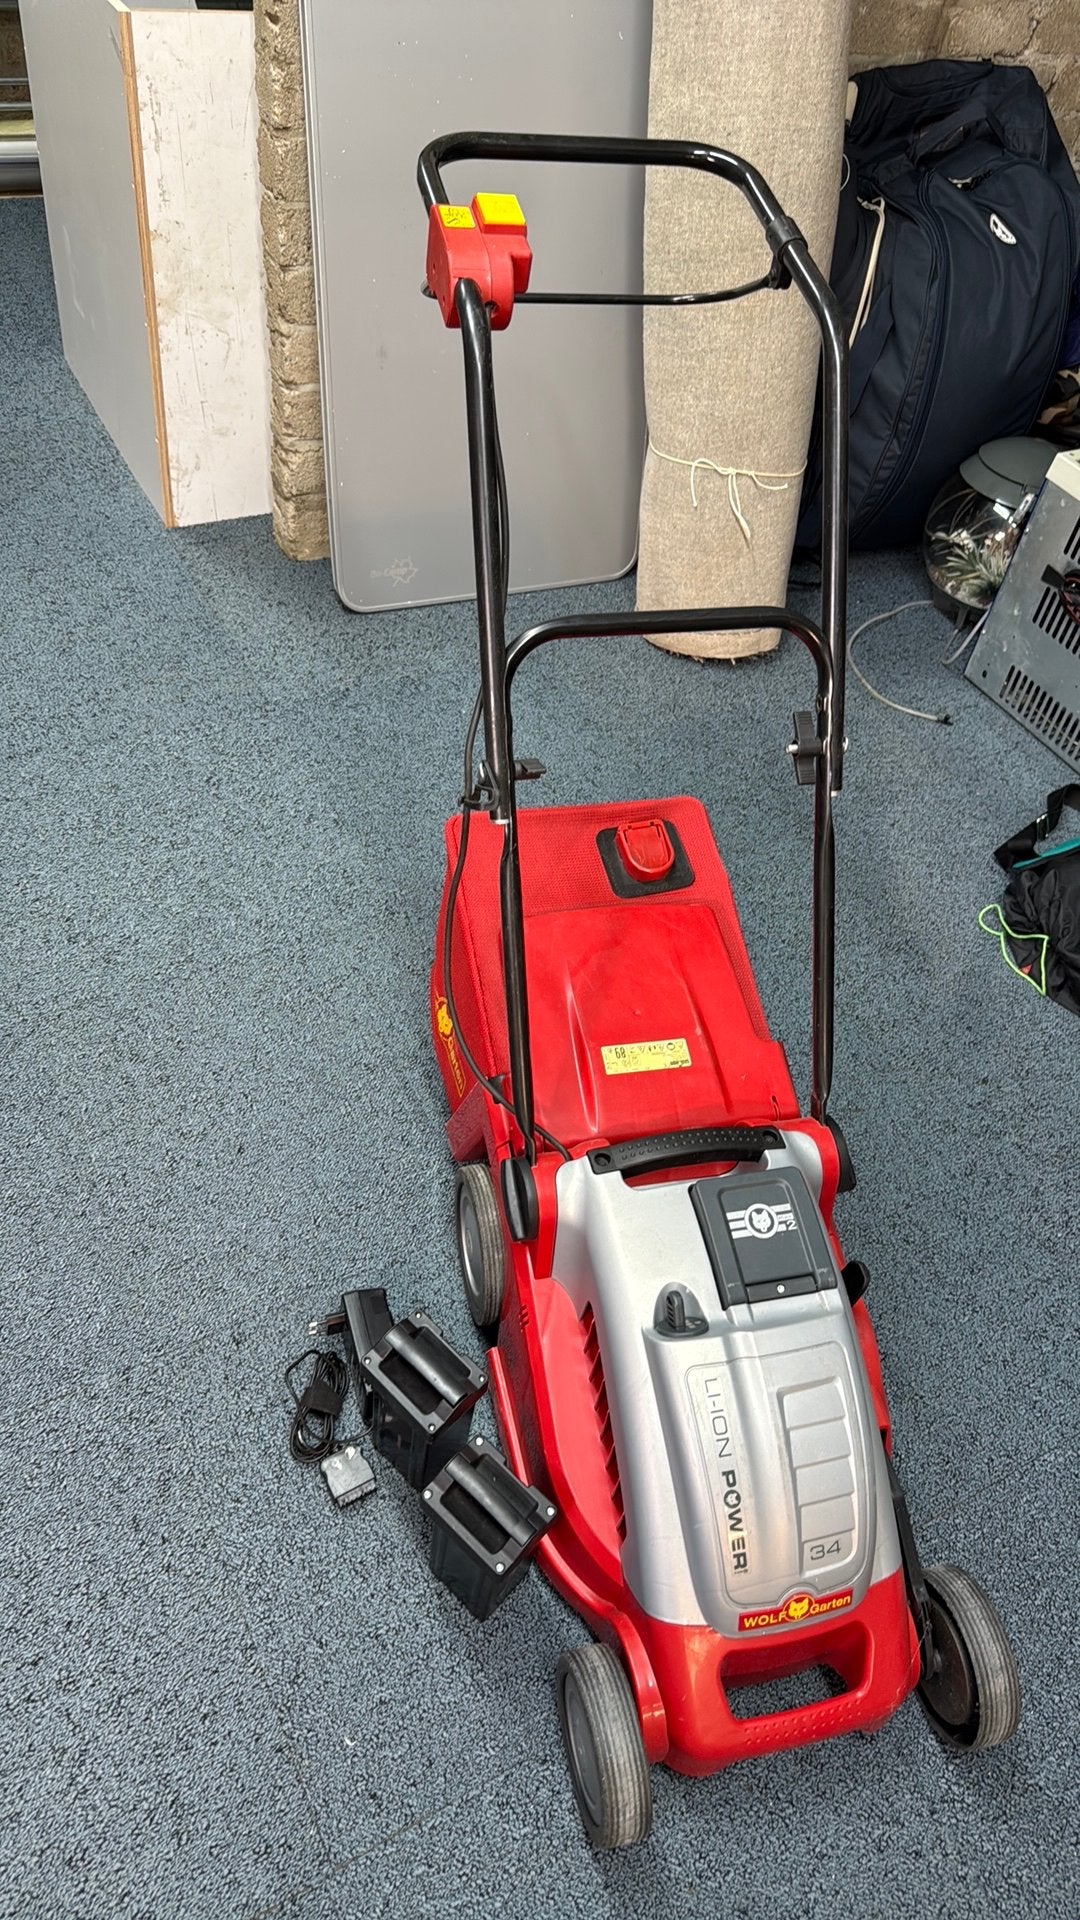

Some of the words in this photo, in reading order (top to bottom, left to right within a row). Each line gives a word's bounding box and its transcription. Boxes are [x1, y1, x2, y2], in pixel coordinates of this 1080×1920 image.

[704, 1377, 733, 1459] LI-ION
[721, 1469, 748, 1570] POWER
[809, 1540, 842, 1561] 34
[743, 1611, 788, 1628] WOLF
[809, 1595, 852, 1615] Garten
